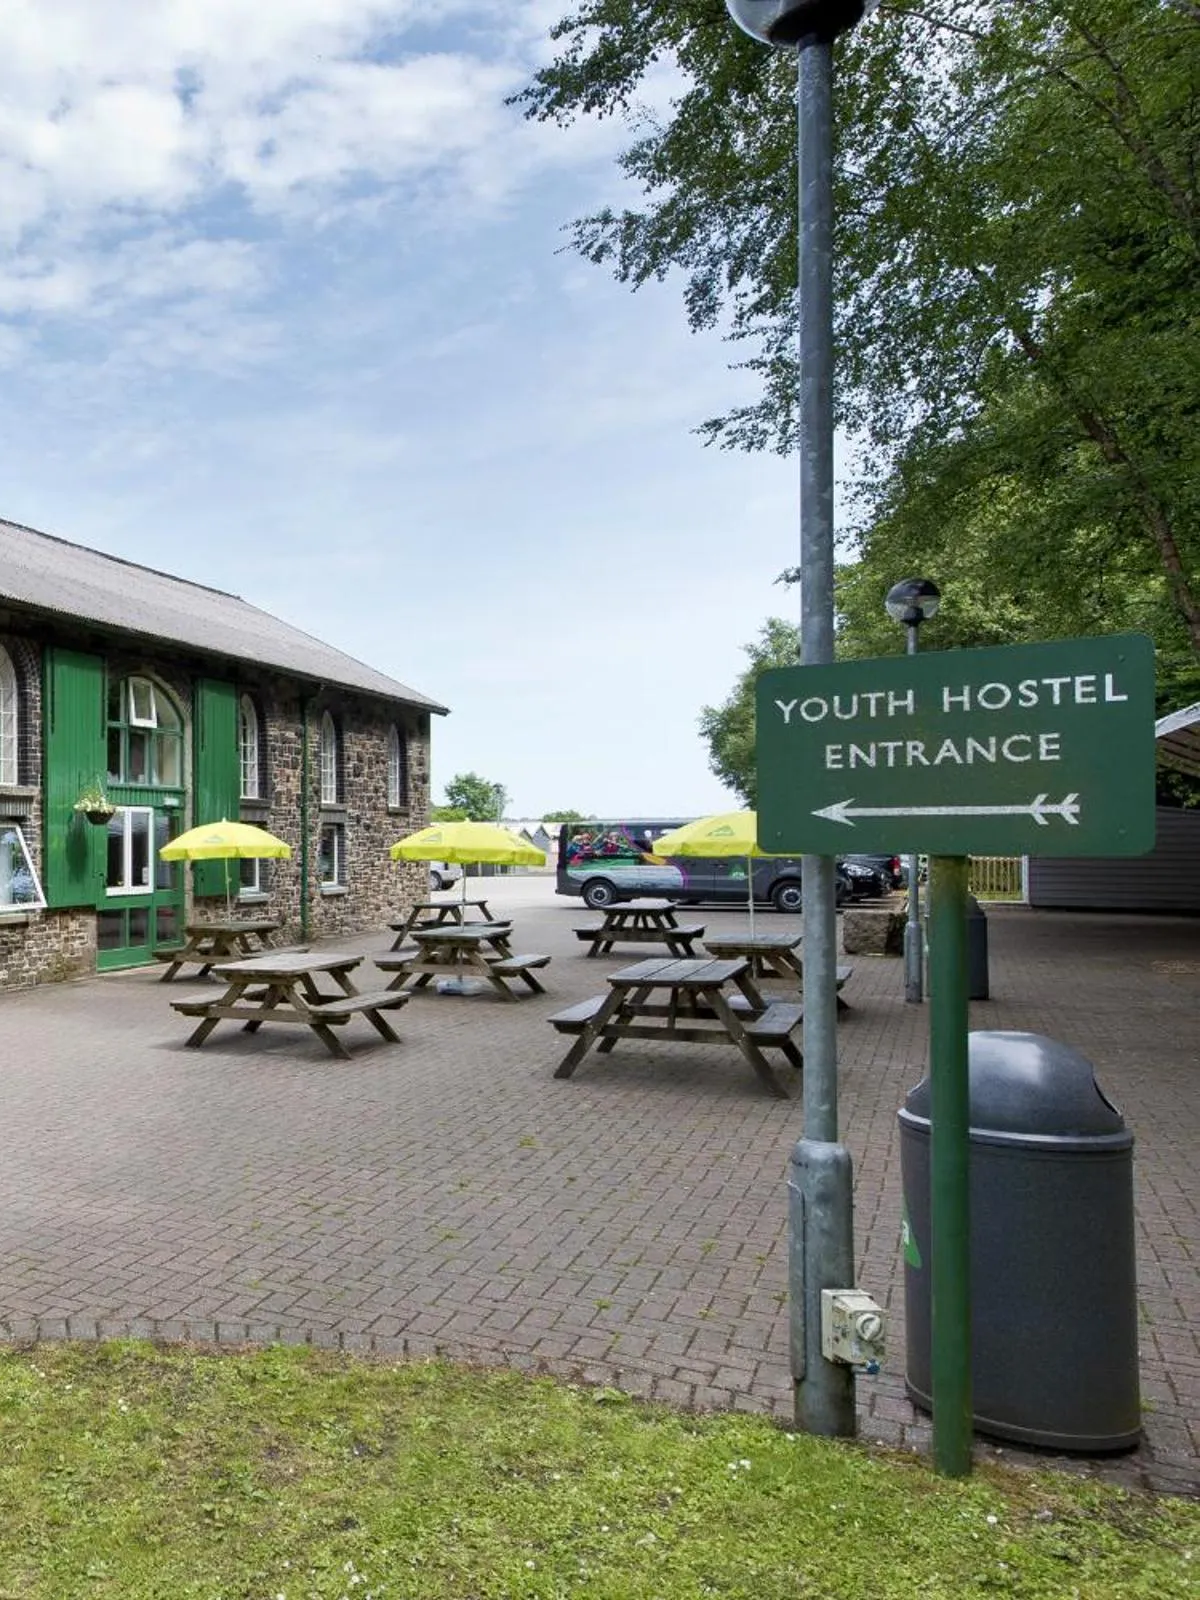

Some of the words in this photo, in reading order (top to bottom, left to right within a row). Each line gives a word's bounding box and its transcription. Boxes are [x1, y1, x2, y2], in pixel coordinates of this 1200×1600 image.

[775, 689, 914, 724] YOUTH
[943, 673, 1129, 713] HOSTEL
[825, 732, 1062, 770] ENTRANCE
